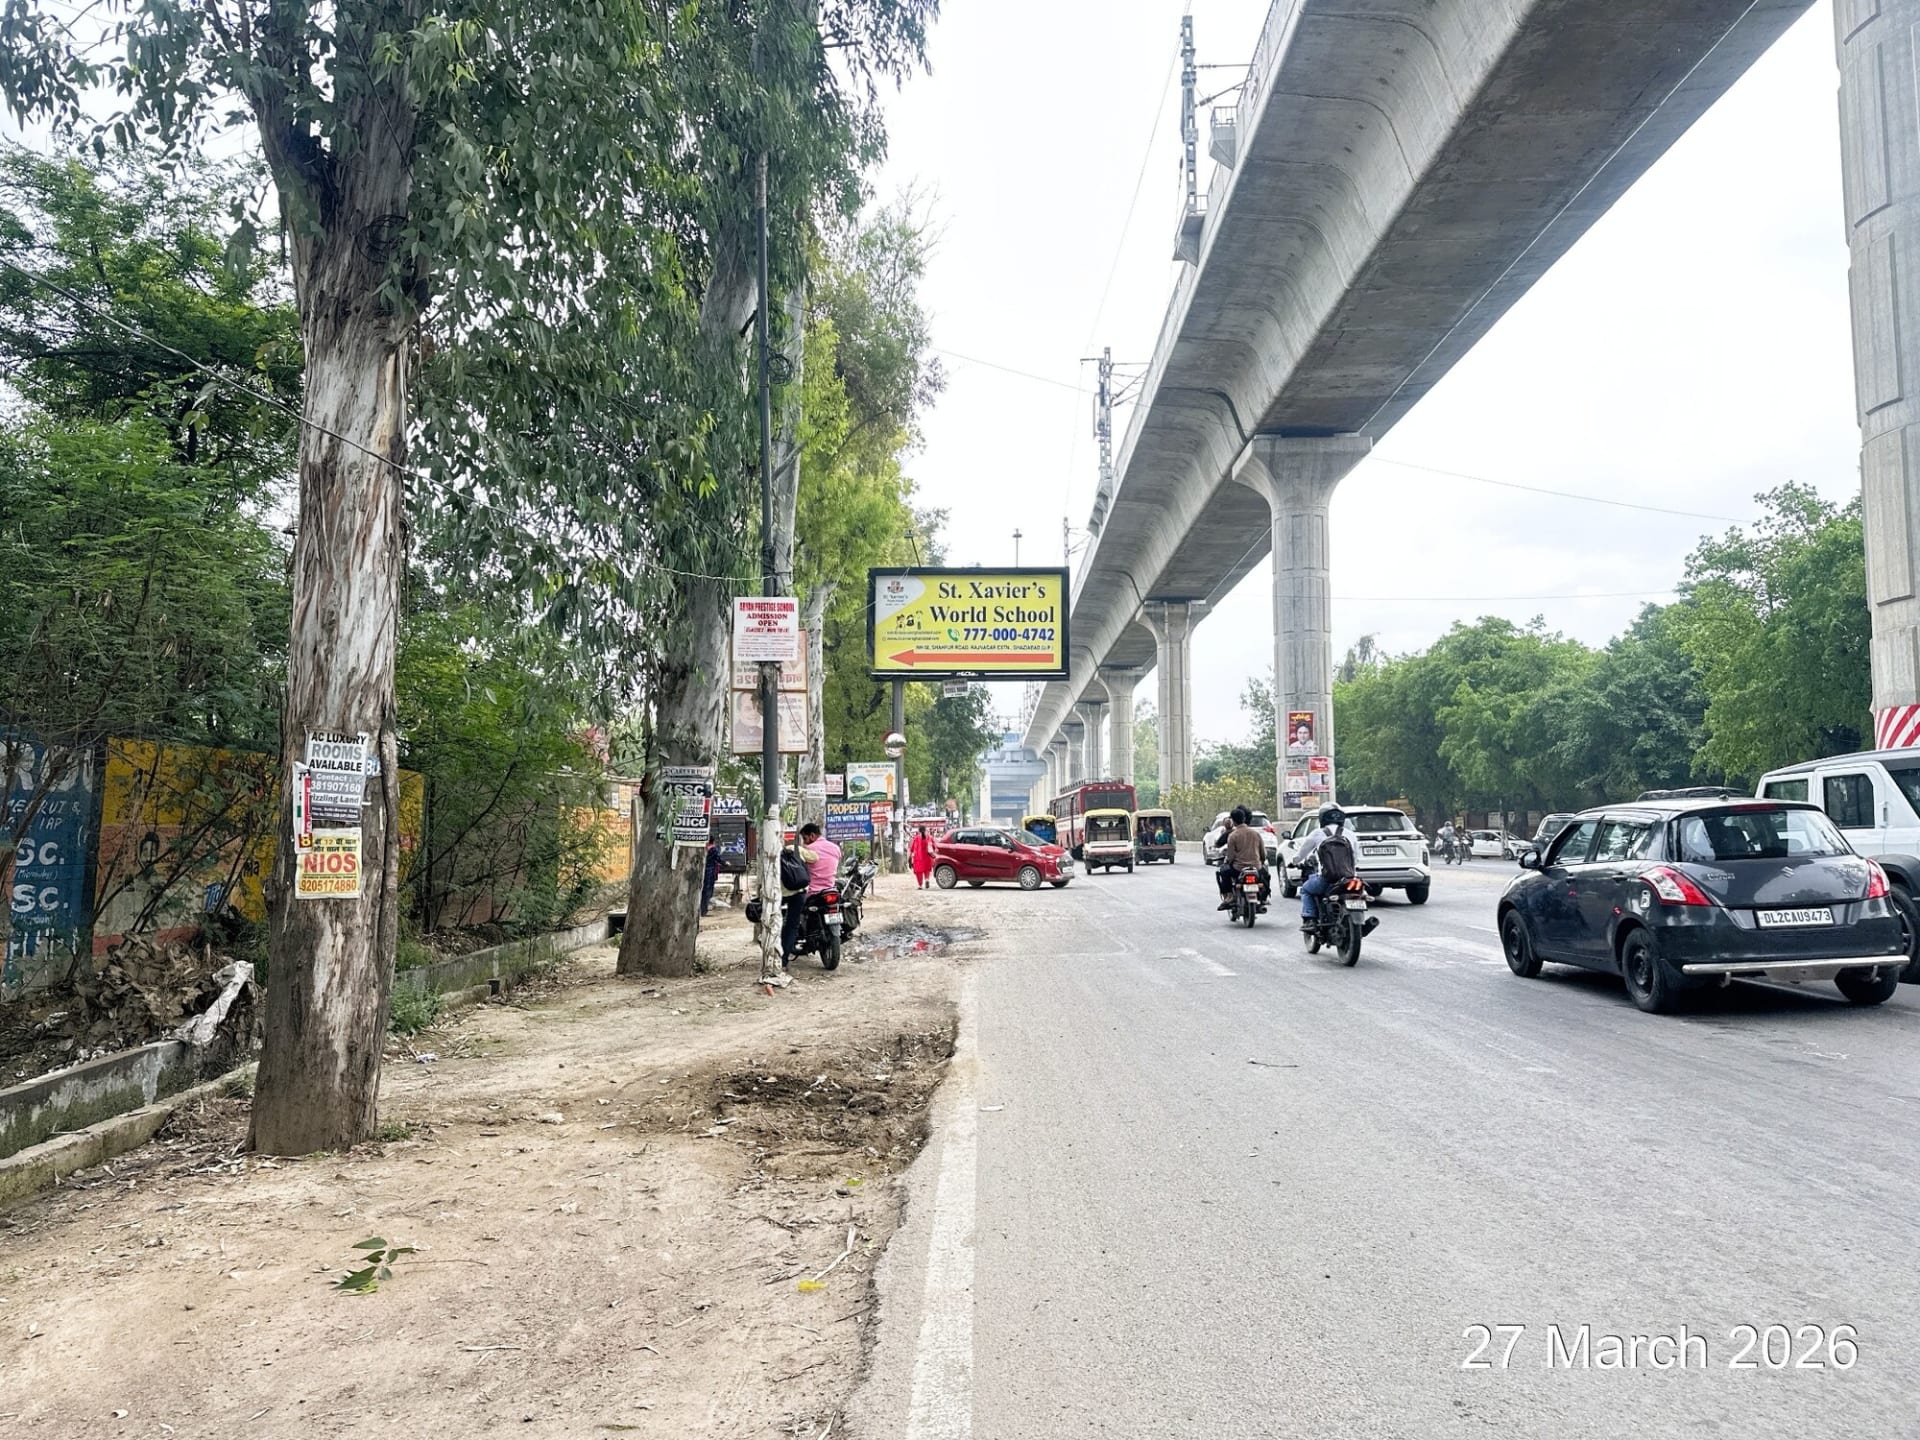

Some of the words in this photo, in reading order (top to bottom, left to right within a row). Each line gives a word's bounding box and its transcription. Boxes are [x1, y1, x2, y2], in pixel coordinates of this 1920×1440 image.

[938, 582, 962, 599] St.
[969, 582, 1046, 599] Xavier’s
[930, 606, 987, 623] World
[993, 606, 1054, 623] School
[964, 628, 1054, 641] 777-000-4742
[311, 731, 325, 742] AC
[312, 744, 362, 760] ROOMS
[309, 759, 362, 772] AVAILABLE
[315, 772, 348, 781] Contact
[310, 781, 361, 793] 381907160
[674, 784, 705, 796] SSC
[310, 792, 338, 804] rizzling
[340, 795, 359, 804] Land
[827, 803, 870, 815] PROPERTY
[672, 816, 707, 827] olice
[304, 853, 356, 873] NIOS
[1763, 910, 1832, 924] DL2CAU9473
